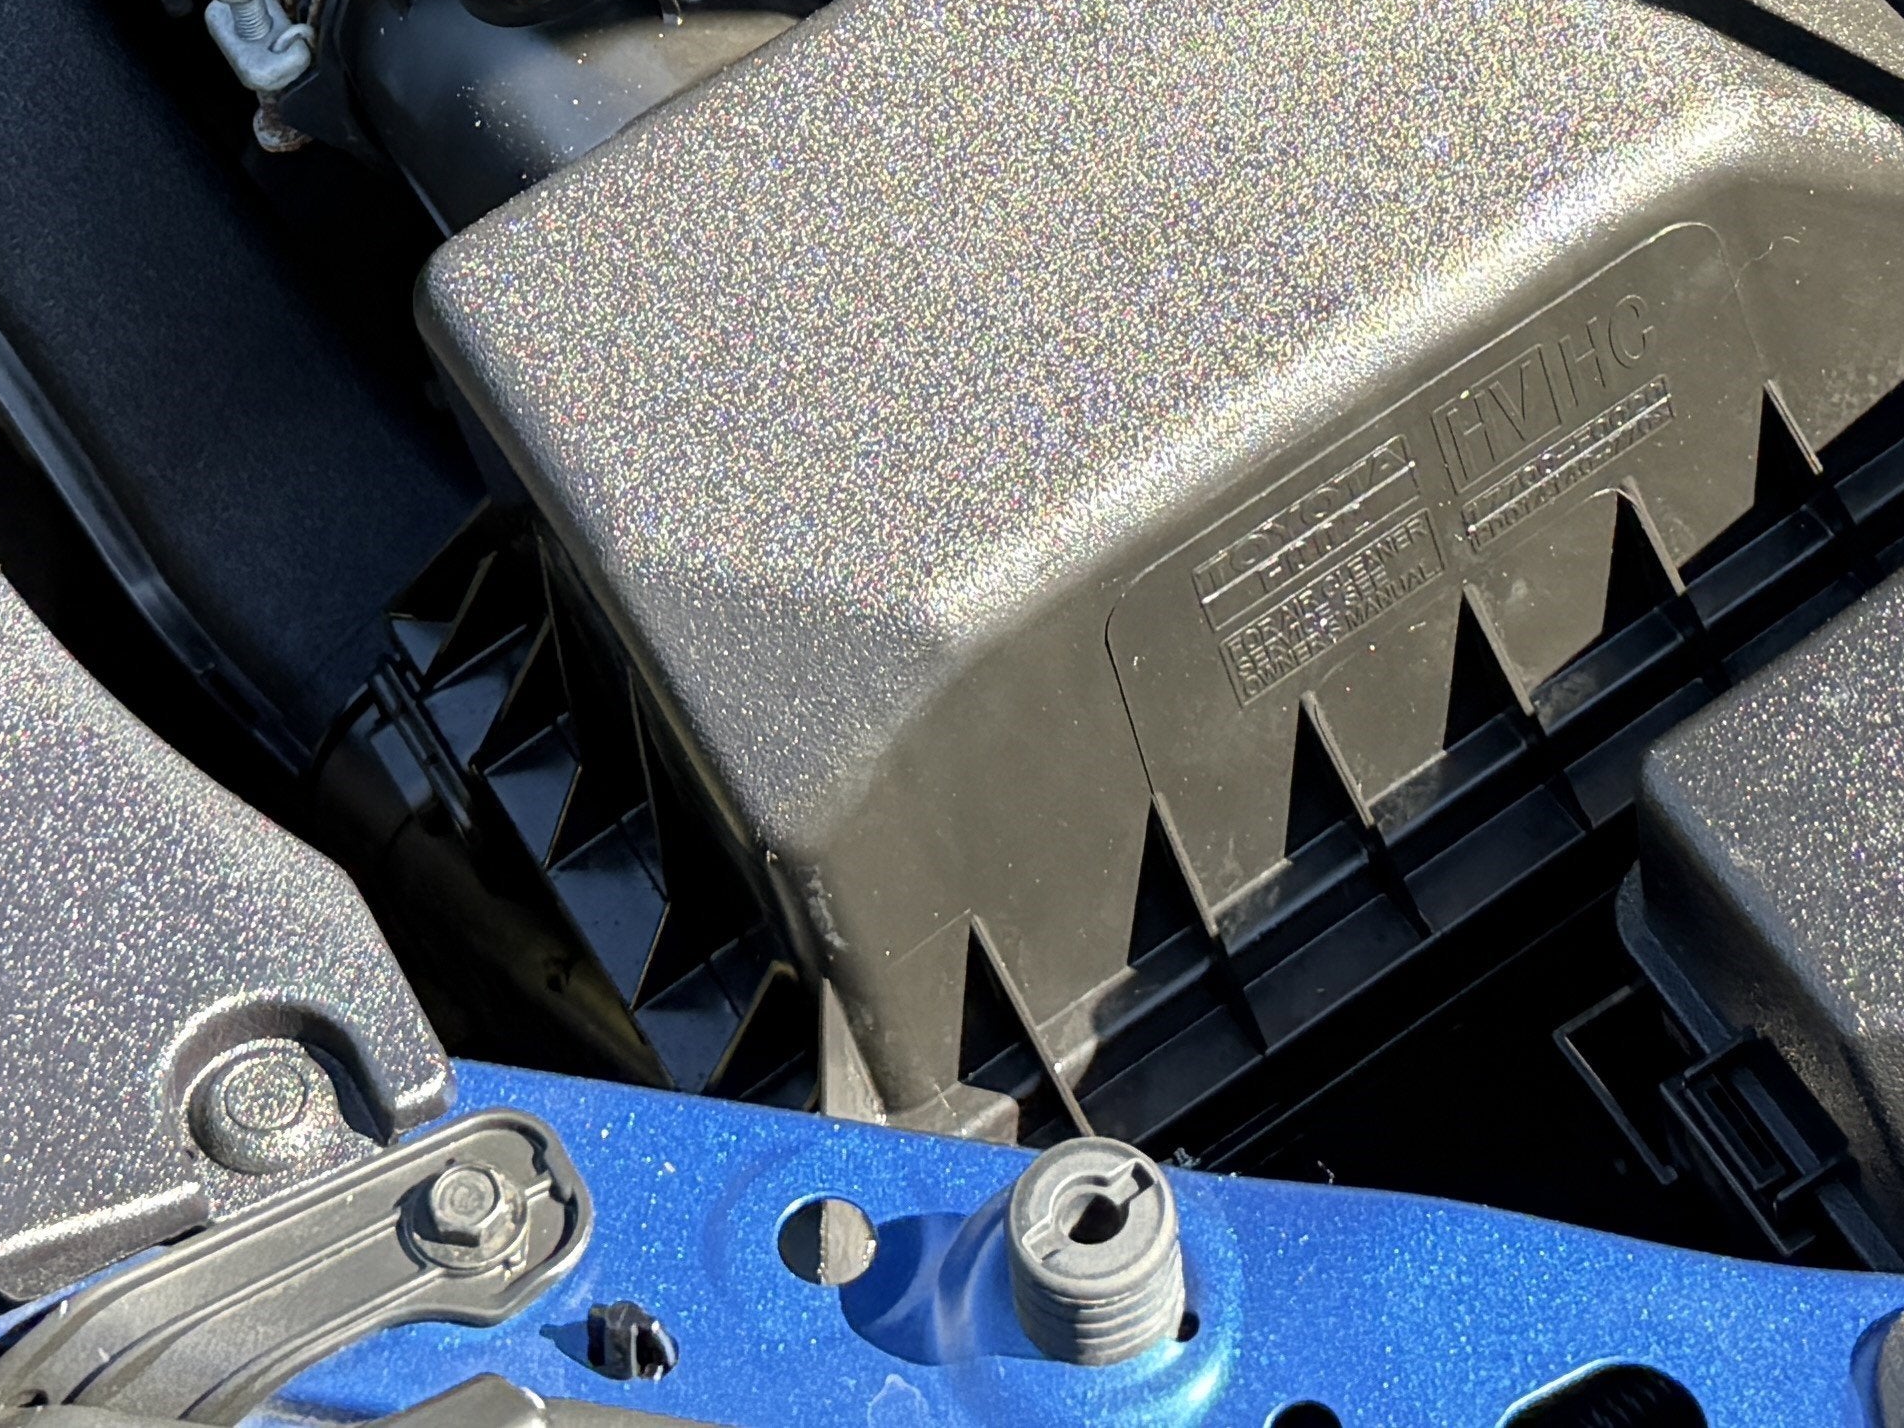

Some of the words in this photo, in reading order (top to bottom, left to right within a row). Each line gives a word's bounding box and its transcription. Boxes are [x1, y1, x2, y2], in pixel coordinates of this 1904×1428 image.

[1444, 358, 1529, 481] HV
[1559, 289, 1657, 407] HC
[1195, 446, 1406, 589] TOYOTA
[1227, 615, 1278, 659] FOR
[1276, 587, 1319, 626] AIR
[1320, 515, 1428, 598] CLEANER
[1340, 563, 1390, 607] SEE
